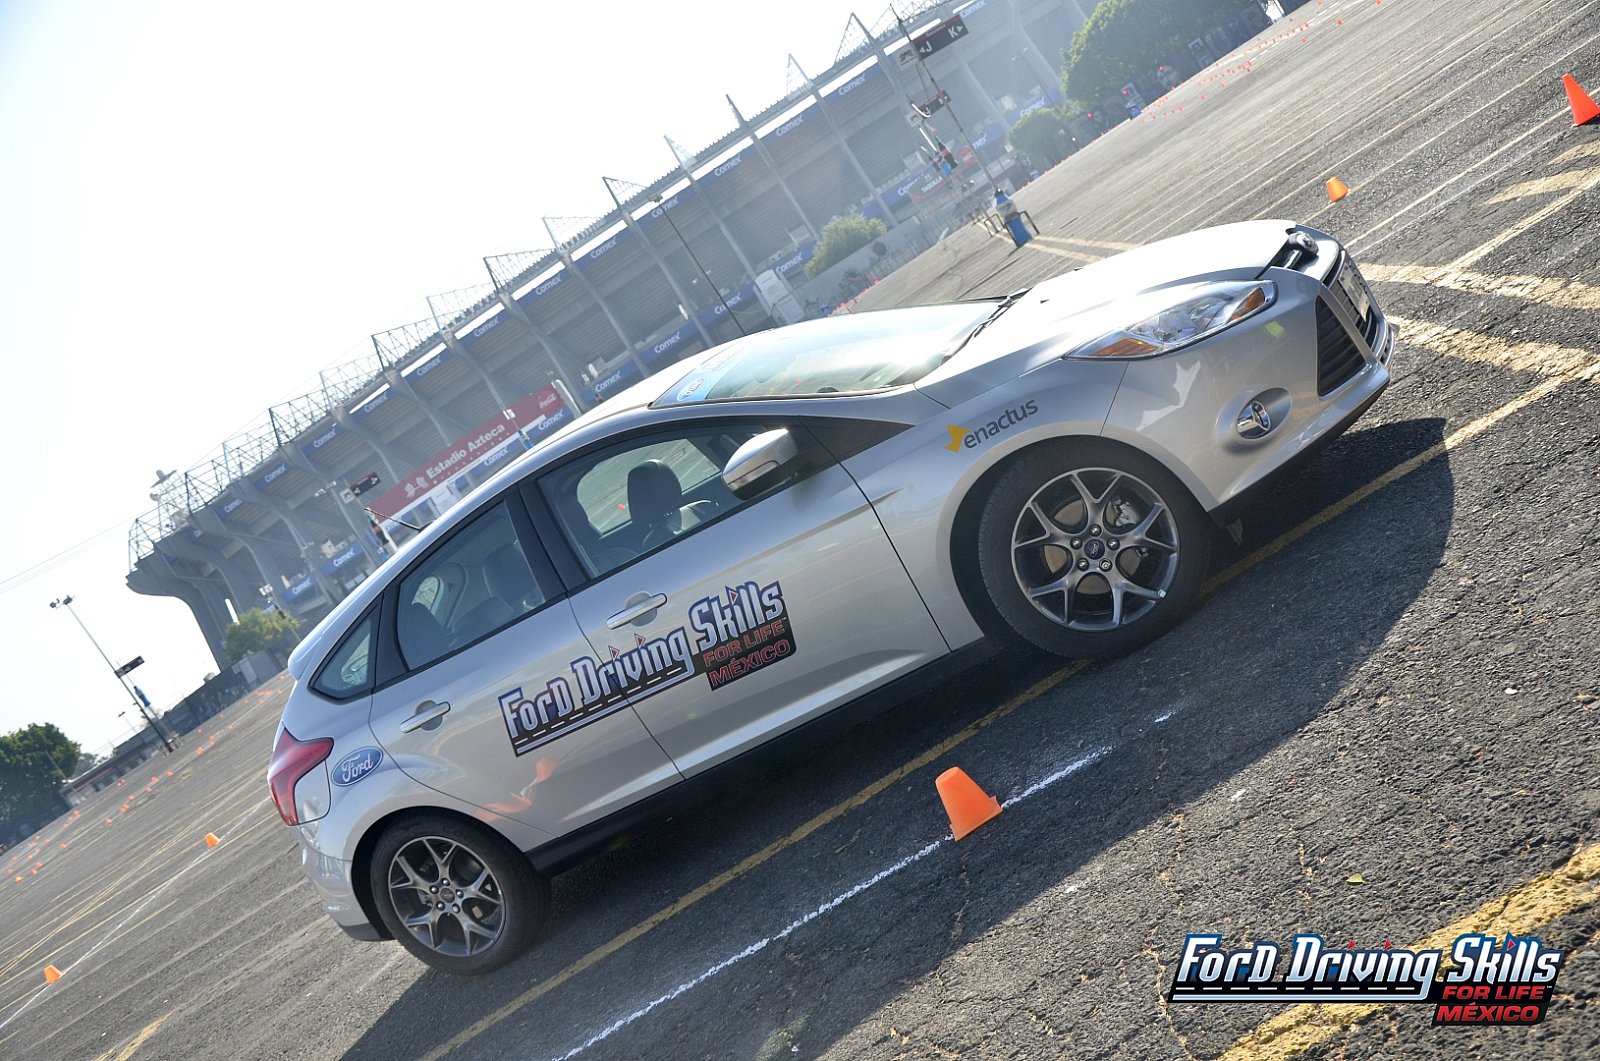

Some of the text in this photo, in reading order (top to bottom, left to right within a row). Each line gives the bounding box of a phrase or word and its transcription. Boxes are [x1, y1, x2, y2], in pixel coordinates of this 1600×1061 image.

[948, 25, 958, 38] K
[838, 74, 867, 96] Comex
[776, 115, 804, 137] Comex
[714, 154, 743, 177] Comex
[651, 196, 679, 218] Comex
[590, 238, 617, 259] Comex
[775, 251, 804, 274] Comex
[535, 275, 562, 296] Comex
[473, 317, 500, 337] Comex
[655, 332, 682, 354] Comex
[416, 356, 442, 376] Comex
[595, 370, 622, 393] Comex
[364, 392, 389, 413] Comex
[538, 411, 564, 430] Comex
[964, 400, 1038, 448] enactus
[314, 429, 337, 448] Comex
[426, 423, 505, 479] Estadio Azteca
[484, 447, 509, 466] Comex
[265, 464, 286, 482] Comex
[333, 550, 355, 567] Comex
[292, 578, 311, 594] Comex
[571, 627, 695, 705] Driving
[689, 581, 784, 651] Skills
[703, 619, 786, 668] FOR LIFE
[709, 638, 791, 687] MÉXICO
[342, 753, 373, 782] Ford
